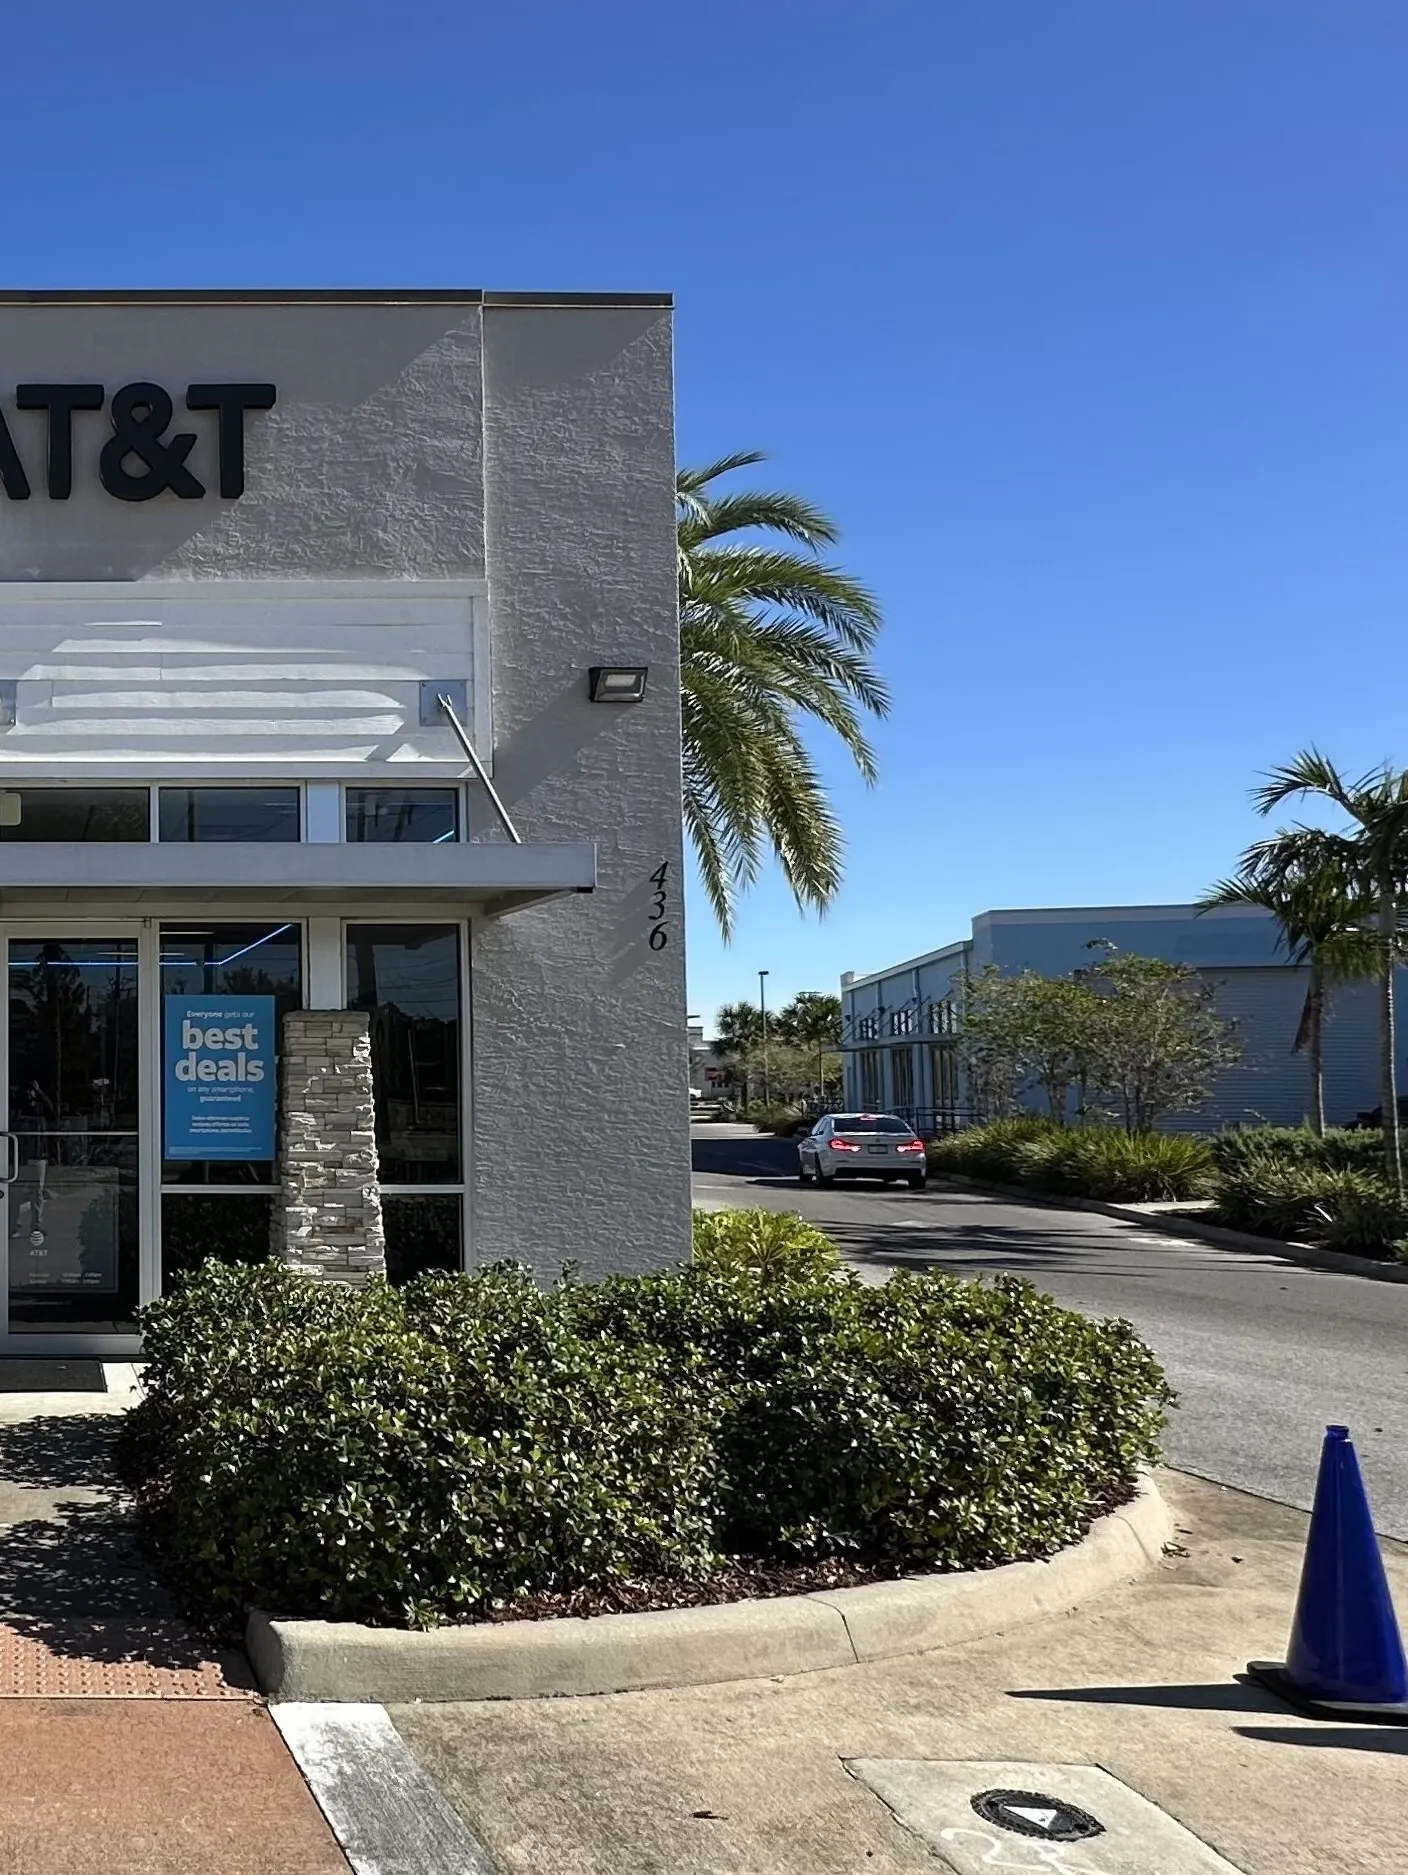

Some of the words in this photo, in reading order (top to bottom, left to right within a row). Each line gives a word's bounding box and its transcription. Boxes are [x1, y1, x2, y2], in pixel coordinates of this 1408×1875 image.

[648, 860, 670, 951] 436
[186, 1010, 223, 1019] Everyone
[182, 1020, 259, 1050] best
[175, 1052, 265, 1082] deals
